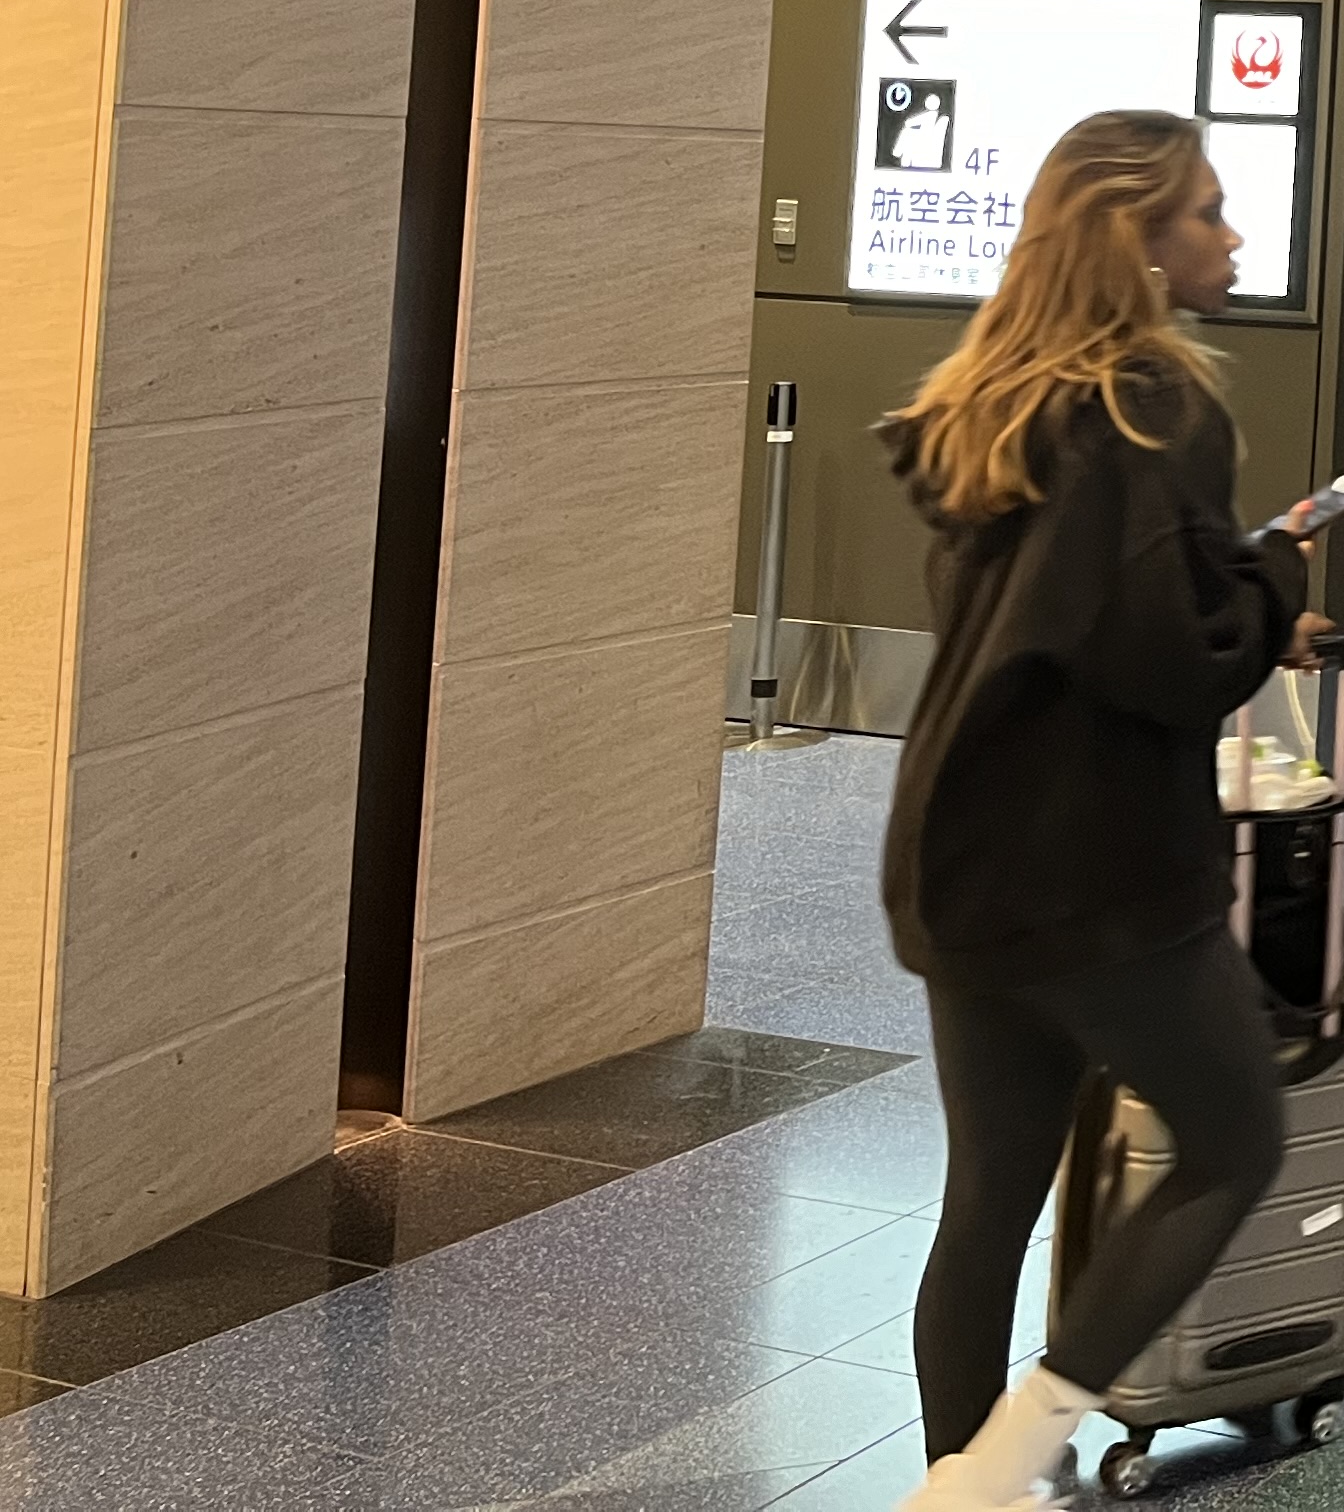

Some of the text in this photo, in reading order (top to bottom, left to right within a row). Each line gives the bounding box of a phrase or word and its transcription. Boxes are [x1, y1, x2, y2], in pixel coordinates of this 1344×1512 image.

[965, 147, 1000, 176] 4F
[869, 186, 1017, 228] 航空会社
[868, 229, 957, 257] Airline
